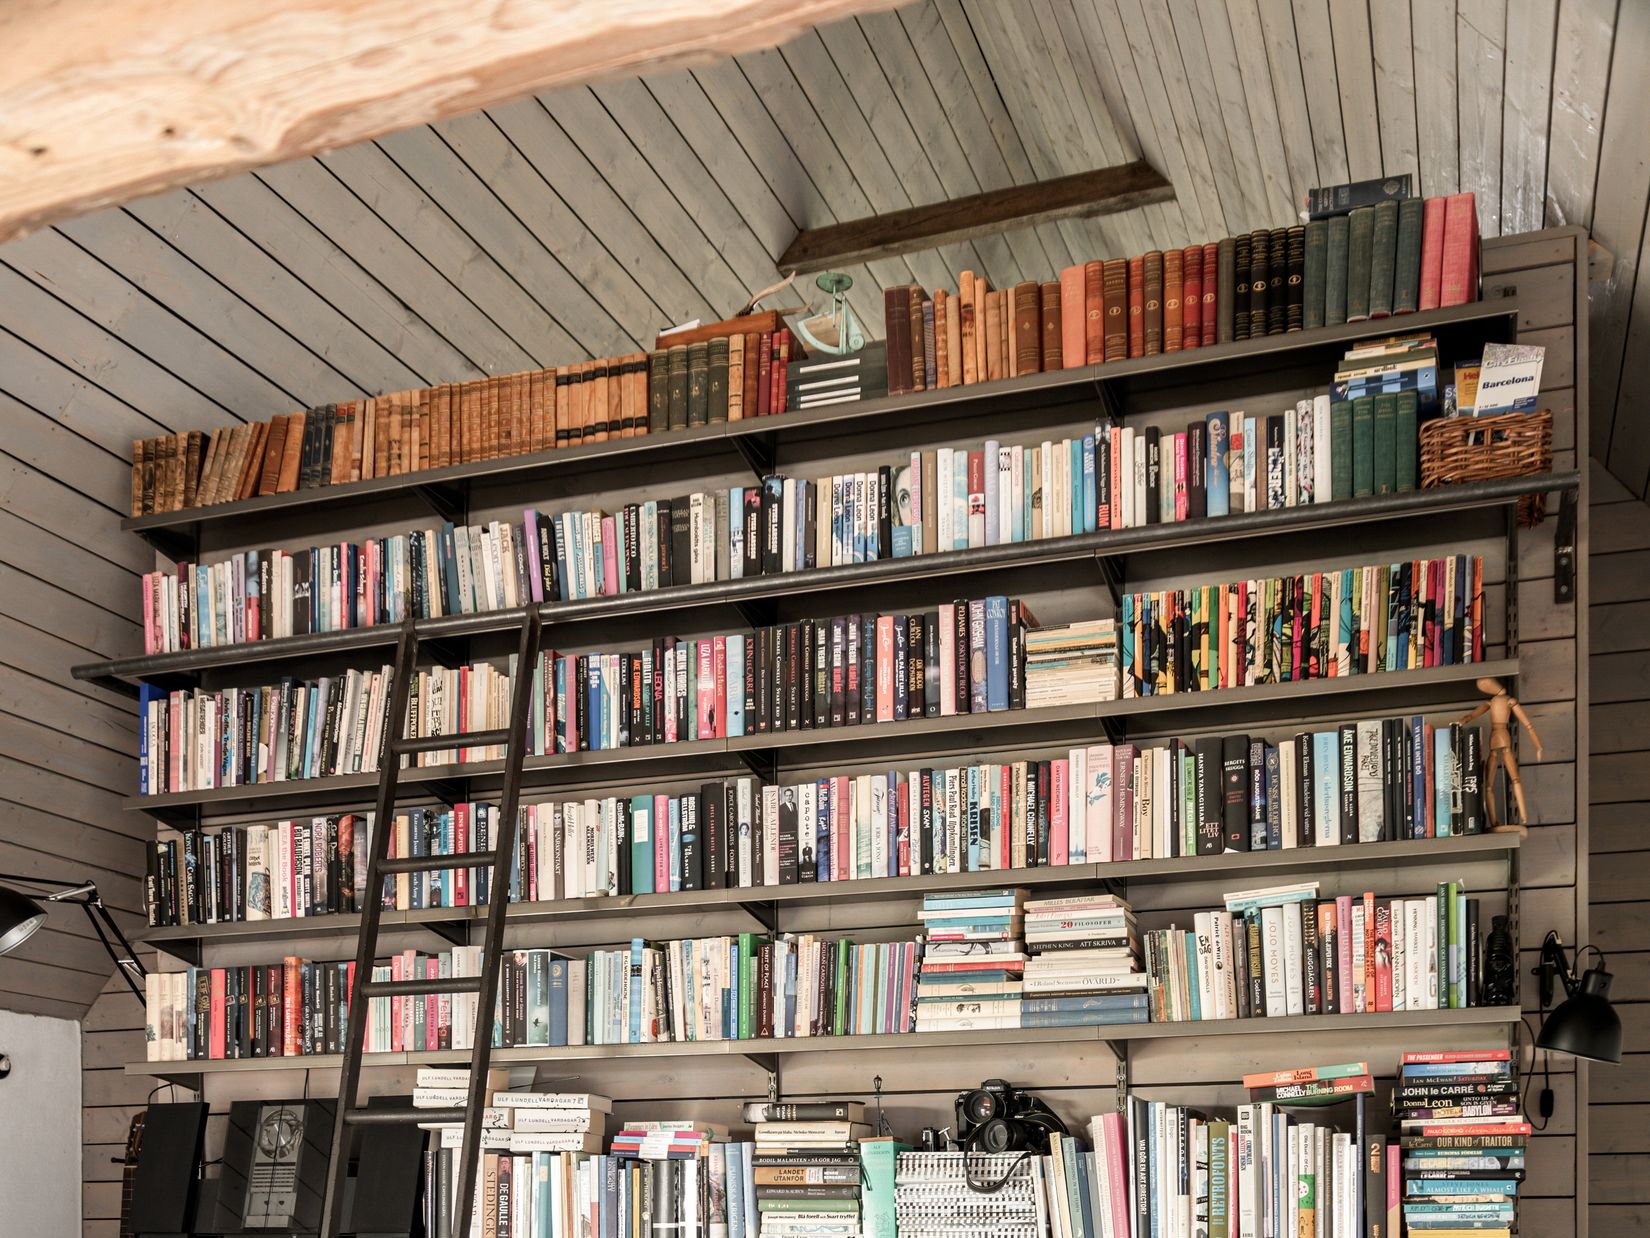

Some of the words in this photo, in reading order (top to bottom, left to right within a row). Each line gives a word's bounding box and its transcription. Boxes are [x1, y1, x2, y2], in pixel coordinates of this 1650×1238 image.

[1482, 375, 1534, 389] Barcelona
[1209, 419, 1226, 468] Sinatra
[833, 484, 841, 505] Donna
[844, 482, 853, 503] Donna
[855, 481, 864, 503] Donna
[869, 481, 877, 503] Donna
[833, 507, 842, 524] Leon
[844, 505, 853, 522] Leon
[856, 504, 864, 521] Leon
[869, 504, 877, 521] Leon
[1099, 505, 1109, 526] RUM
[500, 527, 509, 553] JACK
[556, 538, 565, 560] PEAKS
[633, 659, 641, 670] ÅKE
[958, 640, 966, 677] OSKYLDIGT
[633, 672, 641, 708] EDWARDSON
[654, 671, 663, 700] LEONA
[1343, 730, 1354, 744] ÅKE
[1118, 761, 1126, 786] ERNEST
[1343, 746, 1354, 792] EDWARDSON
[1416, 766, 1422, 775] DÖ
[948, 775, 958, 789] Piers
[949, 790, 958, 802] Paul
[1027, 782, 1035, 808] MICHAEL
[681, 797, 690, 832] HELLSTRÖM
[949, 804, 958, 818] Read
[1118, 787, 1126, 828] HEMINGWAY
[1141, 798, 1150, 816] Boy
[923, 809, 931, 829] SKAM
[1026, 810, 1035, 845] CONNELLY
[1271, 802, 1279, 837] RUDBERG
[313, 823, 323, 842] NORA
[314, 843, 323, 873] ROBERTS
[554, 830, 562, 875] NÄRKONTAKT
[1074, 919, 1112, 927] FILOSOFER
[1268, 920, 1277, 947] JOJO
[1269, 949, 1279, 984] MOYES
[1306, 948, 1314, 999] SKUGGJÄGAREN
[438, 1000, 448, 1036] Felsteg
[1276, 1085, 1300, 1094] MICHAEL
[1306, 1086, 1333, 1095] BURNING
[1334, 1084, 1353, 1092] ROOM
[1403, 1087, 1428, 1096] JOHN
[1441, 1084, 1474, 1094] CARRÉ
[1403, 1100, 1425, 1108] Donna
[1425, 1098, 1452, 1107] Leon
[1462, 1105, 1492, 1116] BABYLON
[1437, 1137, 1451, 1146] OUR
[1453, 1137, 1472, 1146] KIND
[1481, 1136, 1512, 1146] TRAITOR
[1211, 1137, 1225, 1217] RETROFONTS
[499, 1183, 509, 1194] DE
[485, 1171, 496, 1236] STEDINGK
[498, 1195, 509, 1226] GAULLE
